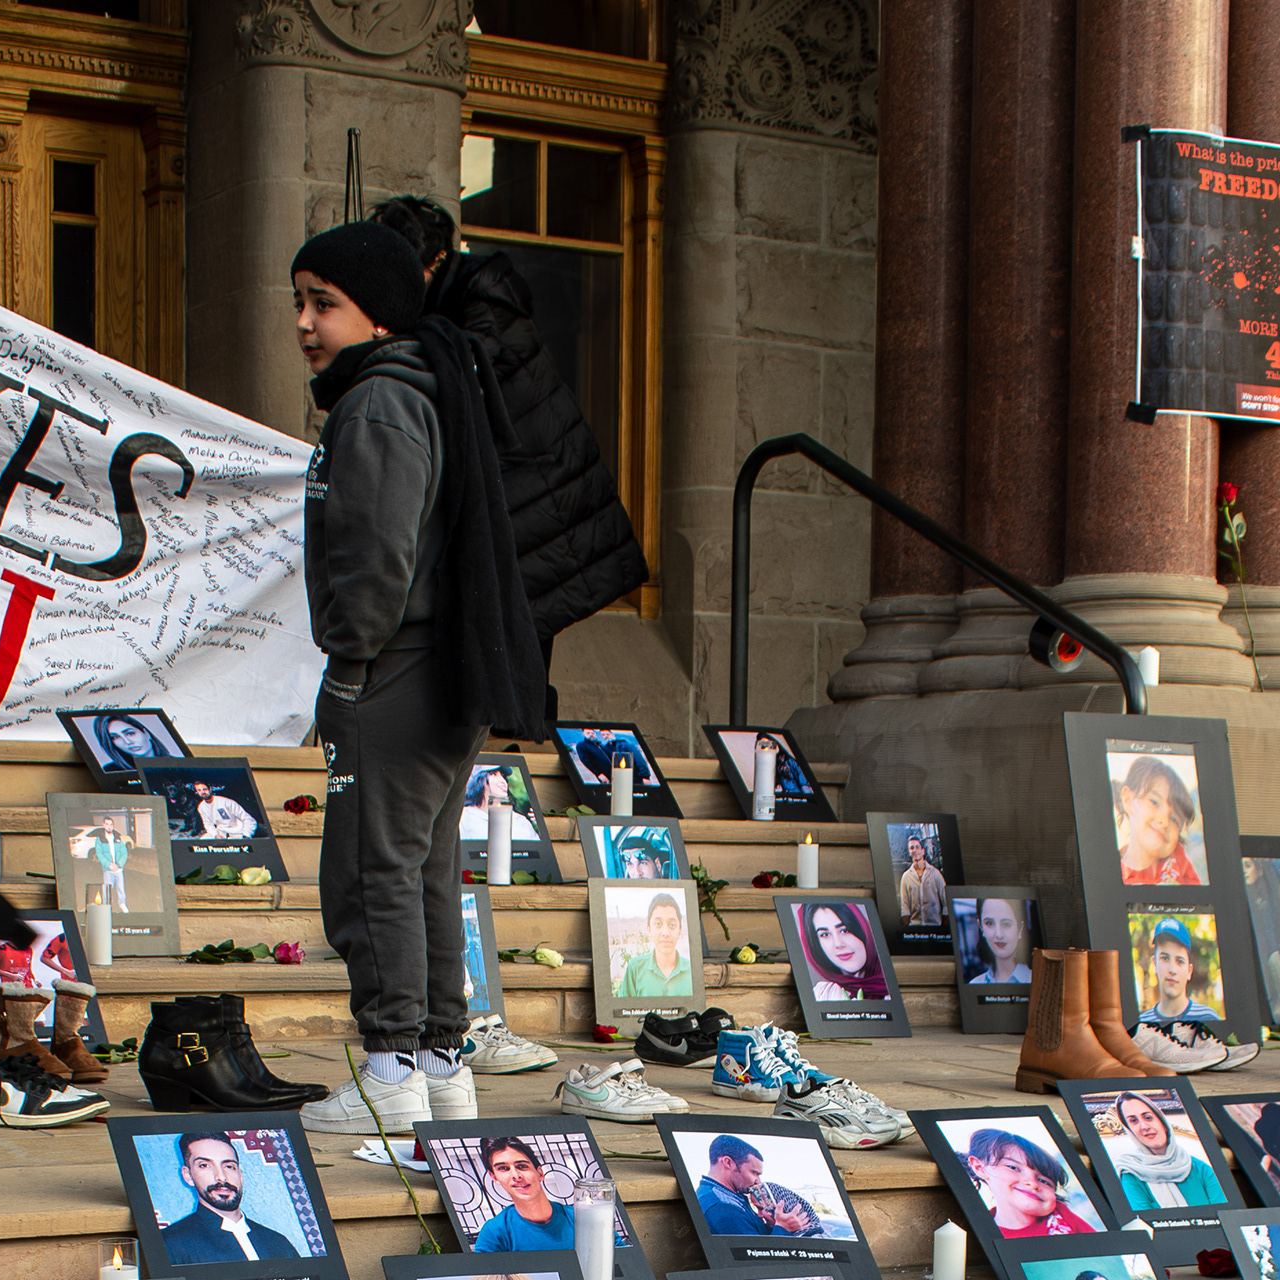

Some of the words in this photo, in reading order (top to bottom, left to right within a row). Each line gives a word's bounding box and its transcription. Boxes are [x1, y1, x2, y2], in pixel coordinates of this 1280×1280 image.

[1176, 142, 1214, 160] What
[1216, 149, 1227, 164] is
[1230, 151, 1254, 168] the
[1239, 319, 1278, 338] MORE
[1242, 393, 1257, 401] We
[1257, 393, 1272, 403] won't
[1241, 401, 1262, 410] DON'T
[1263, 403, 1279, 411] STOP
[75, 658, 115, 672] Hosseini
